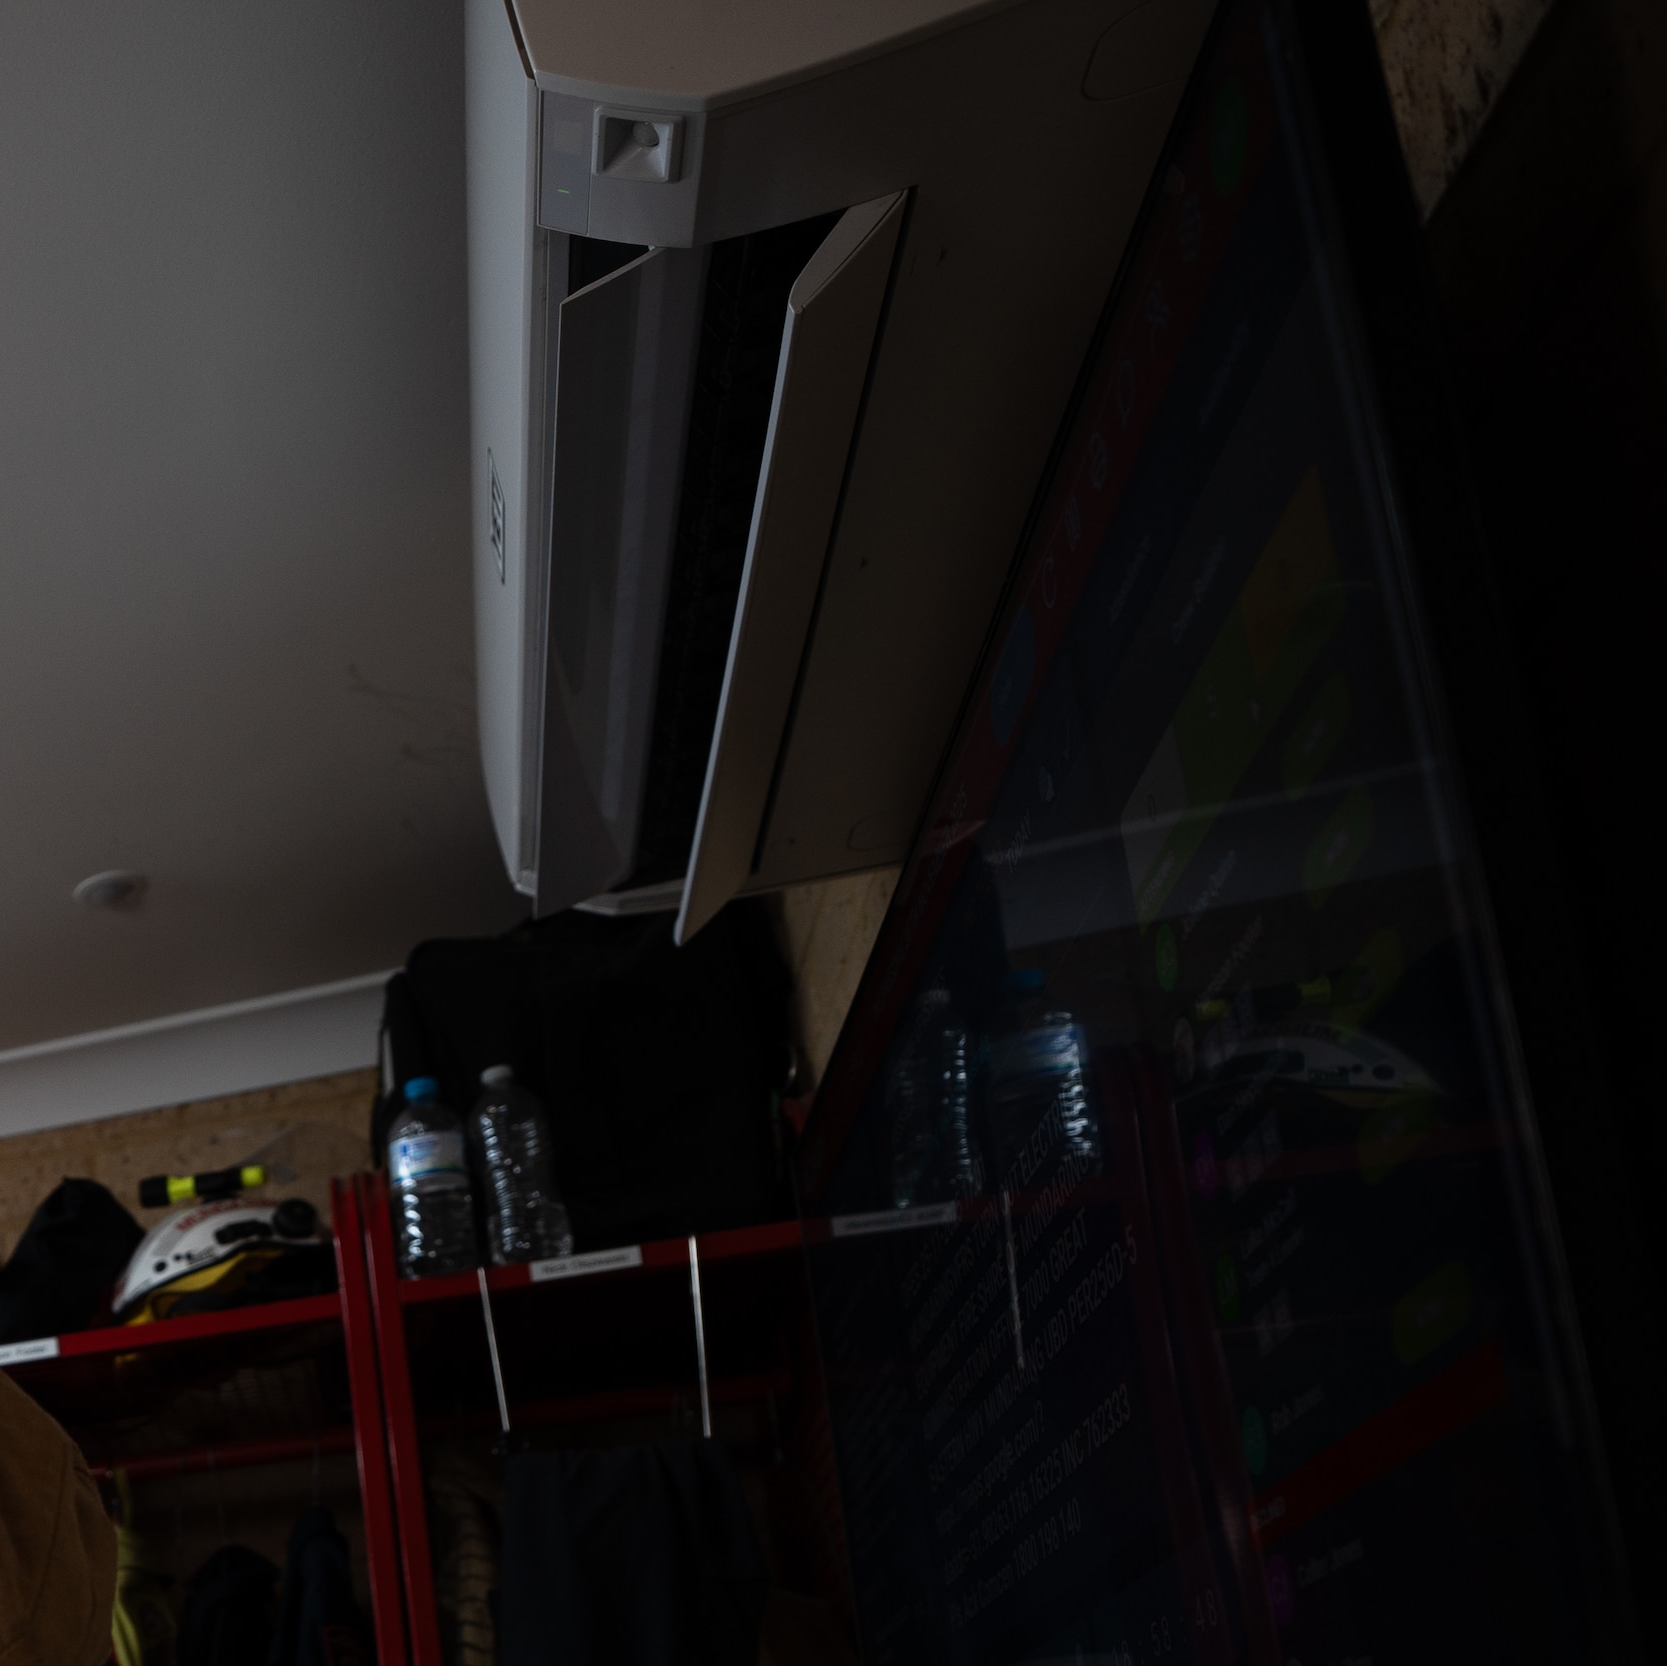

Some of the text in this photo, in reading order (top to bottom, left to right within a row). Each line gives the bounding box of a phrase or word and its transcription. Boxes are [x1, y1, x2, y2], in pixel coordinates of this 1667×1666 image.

[972, 1191, 1000, 1261] TURN
[997, 1159, 1021, 1223] OUT
[957, 1289, 979, 1345] FIRE
[976, 1249, 1007, 1319] SHIRE
[1023, 1255, 1051, 1320] 7000
[1048, 1203, 1090, 1287] GREAT
[983, 1330, 1045, 1433] MUNDARING
[1044, 1303, 1069, 1363] UBD
[1067, 1218, 1139, 1337] PER256D-5
[1060, 1423, 1085, 1479] INC
[1082, 1376, 1132, 1458] 762333
[1012, 1530, 1040, 1584] 1800
[1037, 1513, 1060, 1563] 198
[1058, 1493, 1083, 1547] 140
[1149, 1613, 1173, 1661] 58
[1191, 1585, 1219, 1637] 48
